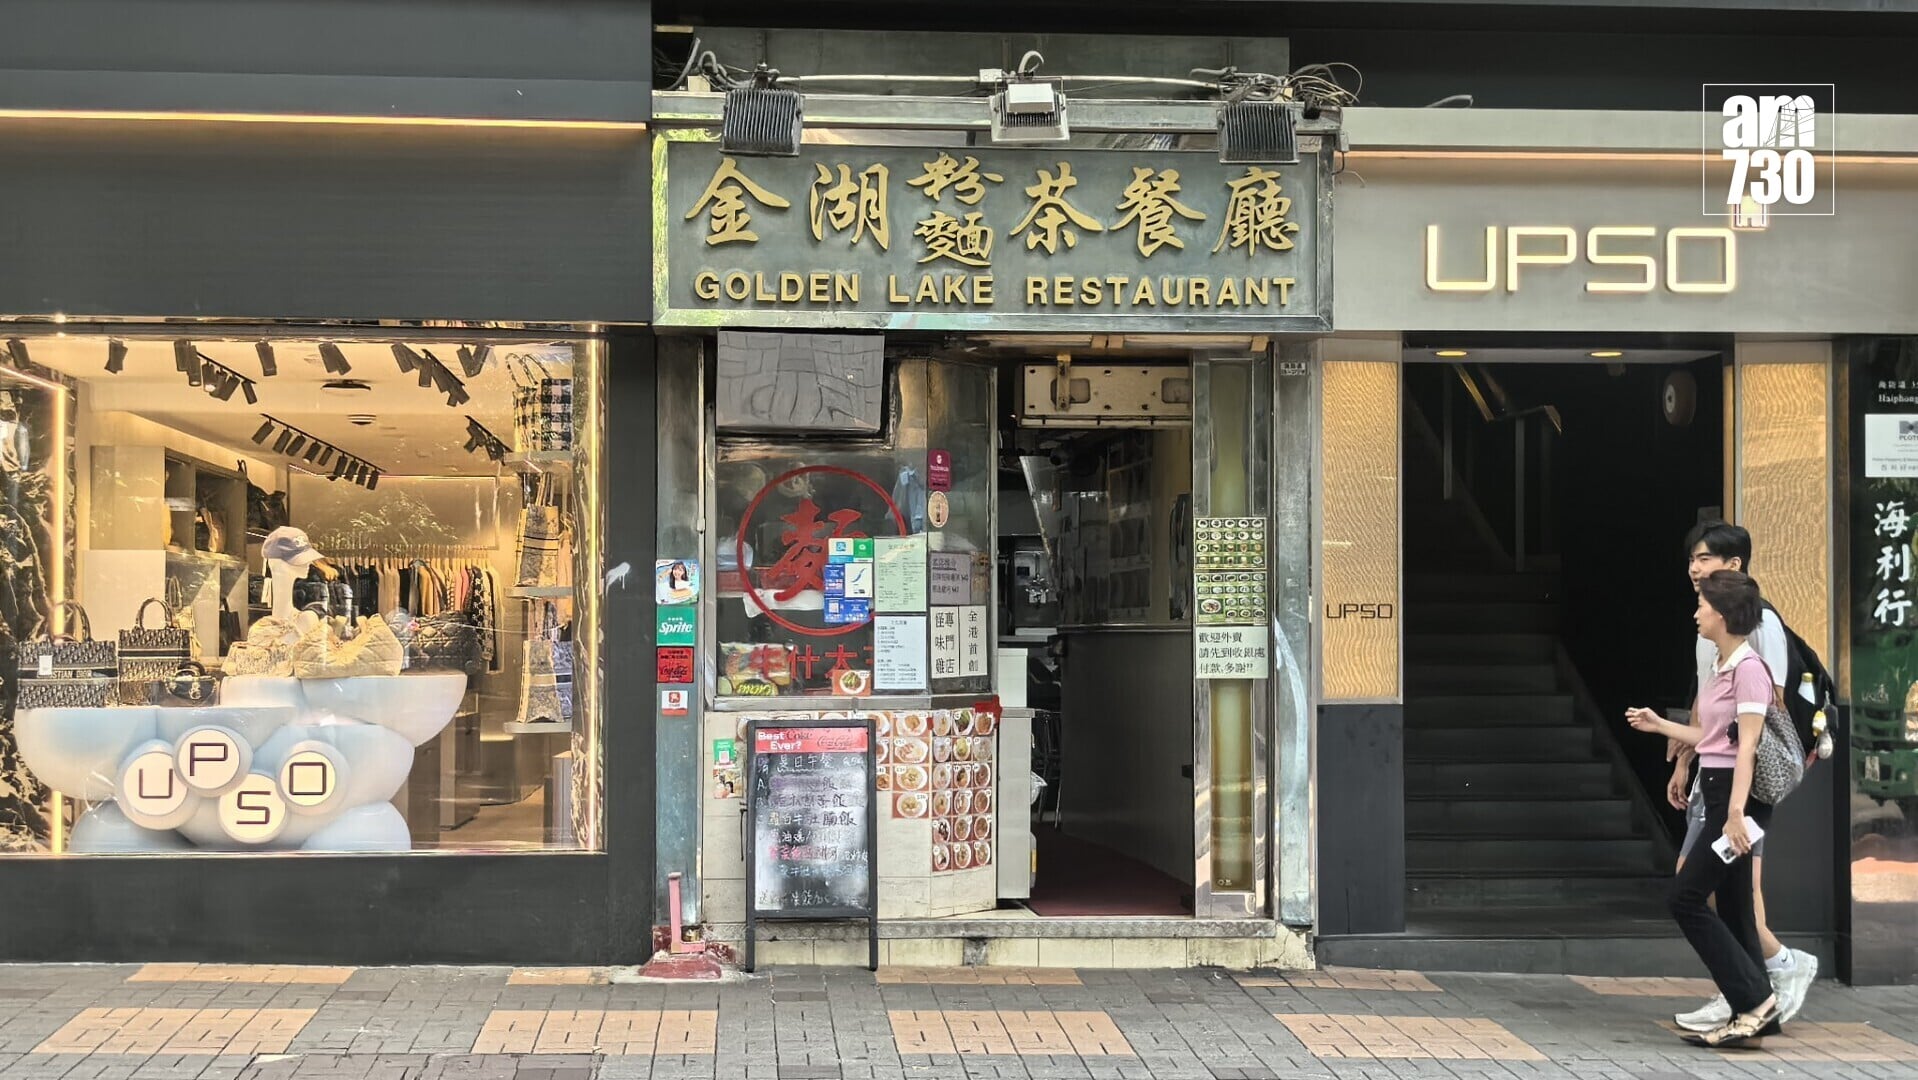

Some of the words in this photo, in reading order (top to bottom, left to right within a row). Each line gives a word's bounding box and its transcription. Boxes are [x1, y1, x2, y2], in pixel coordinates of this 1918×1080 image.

[685, 152, 1300, 266] 金湖粉麵茶餐廳
[1426, 224, 1736, 293] UPSO
[694, 273, 860, 303] GOLDEN
[888, 275, 995, 304] LAKE
[1025, 276, 1296, 305] RESTAURANT
[1873, 500, 1913, 626] 海利行
[1325, 603, 1393, 620] UPSO
[659, 621, 693, 635] Sprite
[758, 731, 785, 740] Best
[770, 741, 802, 750] Ever?
